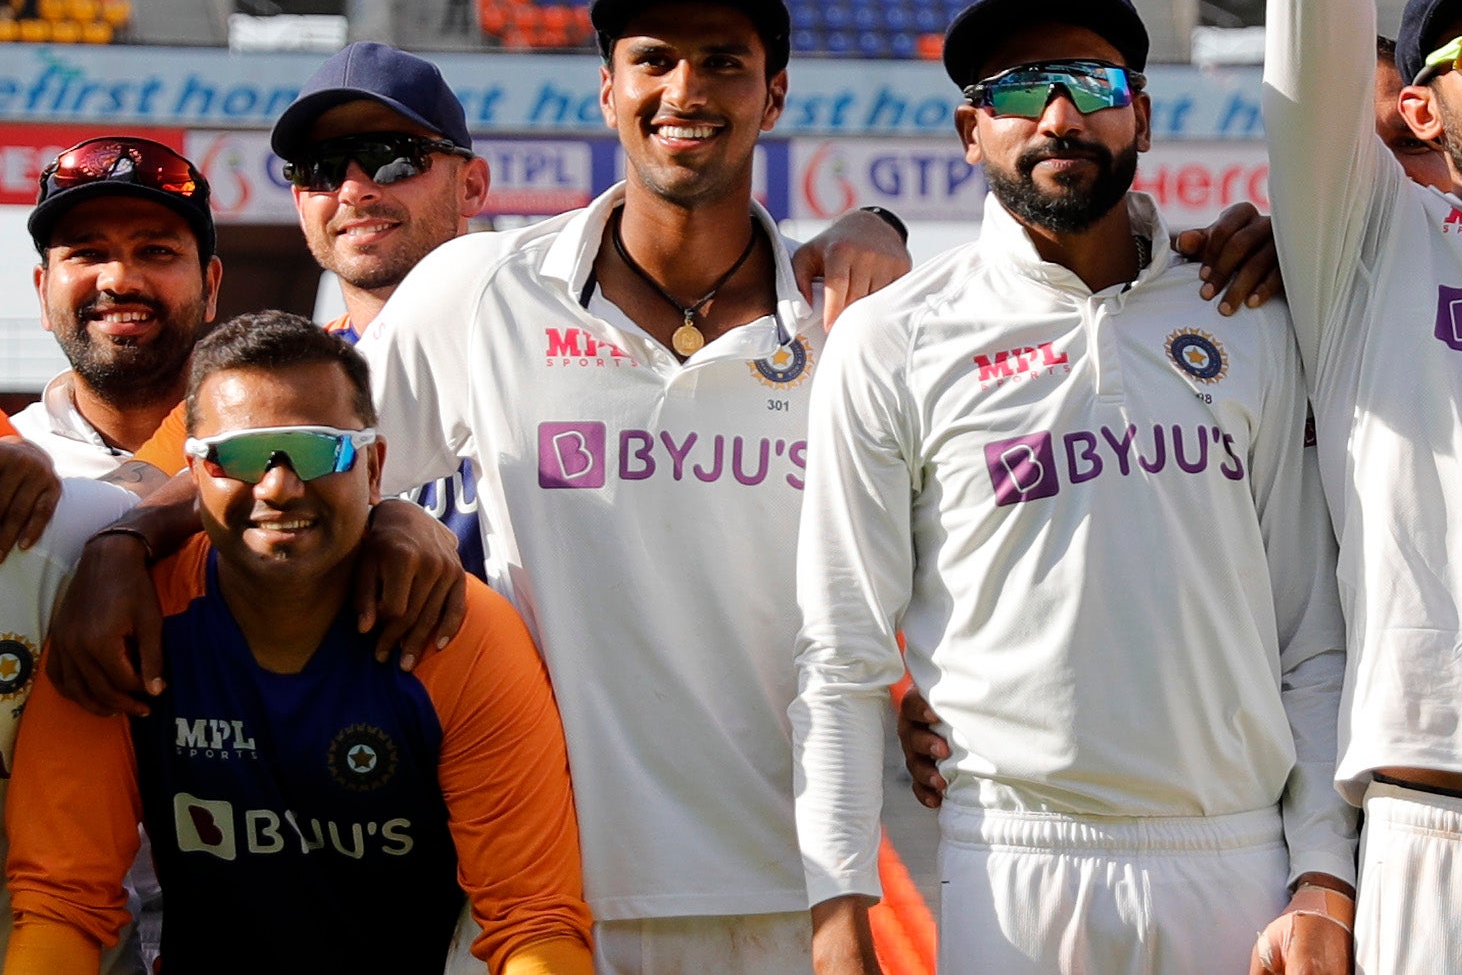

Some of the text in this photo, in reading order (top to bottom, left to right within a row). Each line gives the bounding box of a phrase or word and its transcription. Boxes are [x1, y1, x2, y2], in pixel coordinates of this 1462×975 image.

[869, 154, 976, 198] GTP
[546, 357, 639, 368] SPORTS
[972, 340, 1069, 383] MPL
[767, 399, 790, 412] 301
[618, 429, 808, 491] BYJU'S
[1063, 423, 1245, 484] BYJU'S
[175, 717, 256, 750] MPL
[176, 746, 258, 760] SPORTS
